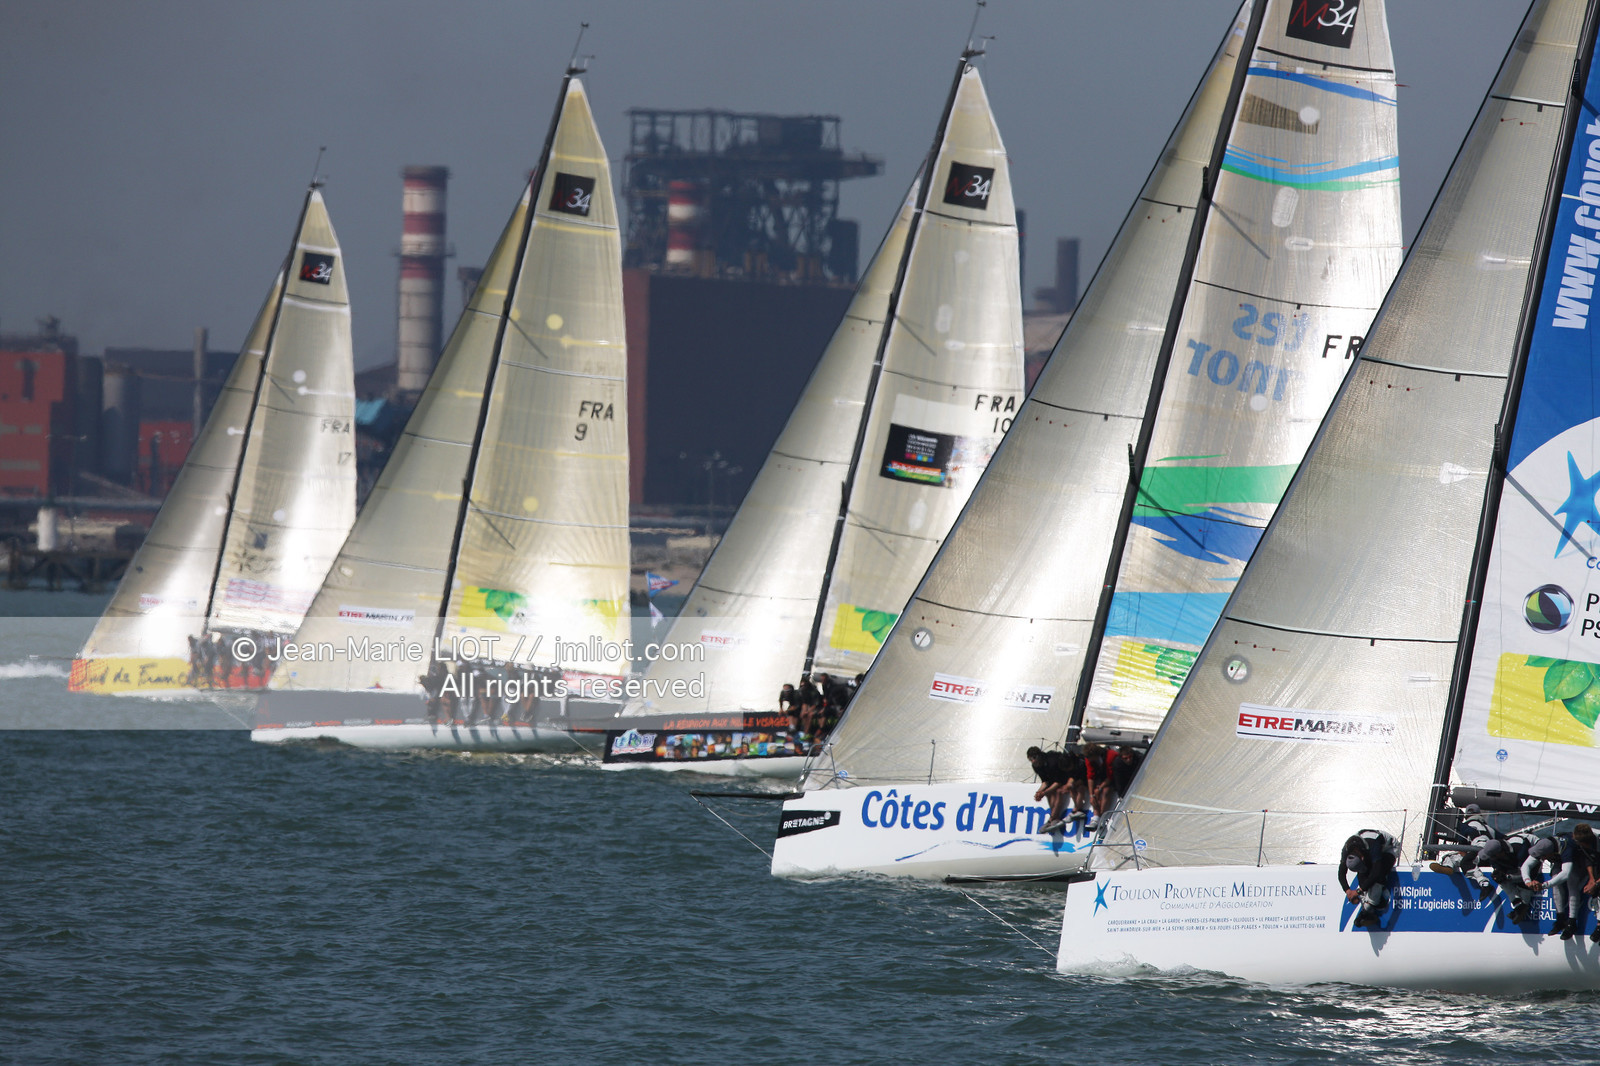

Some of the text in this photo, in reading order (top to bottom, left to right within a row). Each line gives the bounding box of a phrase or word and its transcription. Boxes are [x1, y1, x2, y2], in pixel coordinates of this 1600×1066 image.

[578, 400, 614, 420] FRA
[974, 394, 1016, 413] FRA
[320, 418, 350, 433] FRA
[574, 423, 588, 441] 9
[861, 788, 946, 829] Côtes
[782, 816, 825, 829] BRETAGNE
[1111, 880, 1327, 901] TOULON PROVENCE MÉDITERRANÉE
[1418, 899, 1455, 911] Logiciels
[1456, 899, 1482, 910] Santé
